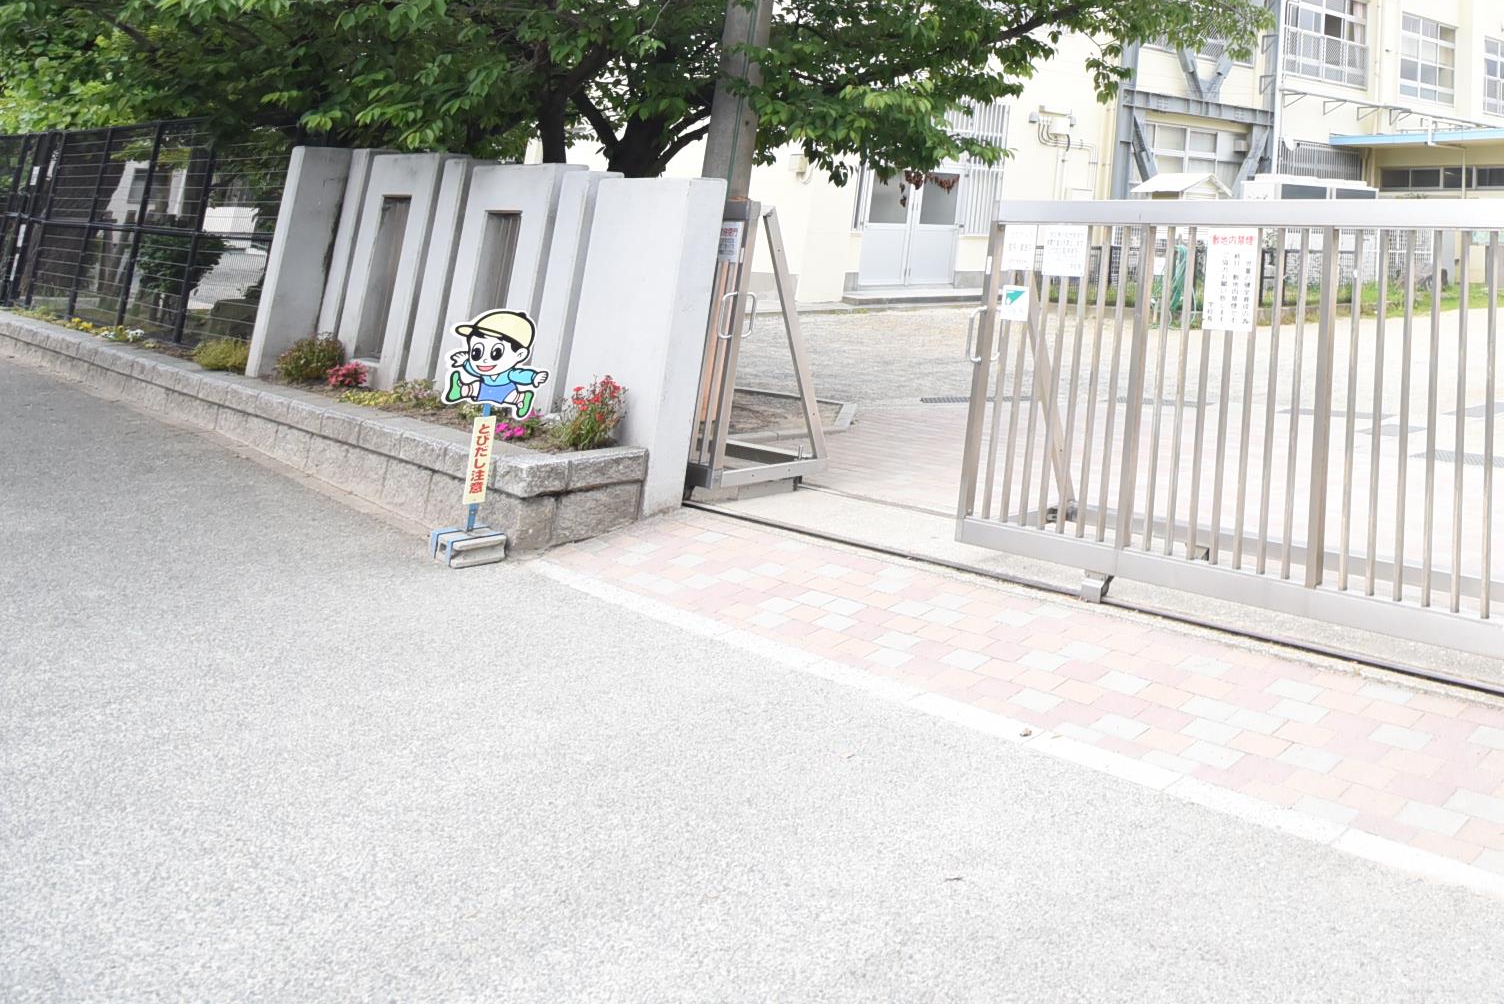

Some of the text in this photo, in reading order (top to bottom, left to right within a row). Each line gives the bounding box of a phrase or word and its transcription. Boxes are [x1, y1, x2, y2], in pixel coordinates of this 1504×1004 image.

[469, 423, 490, 494] とびだし注意
